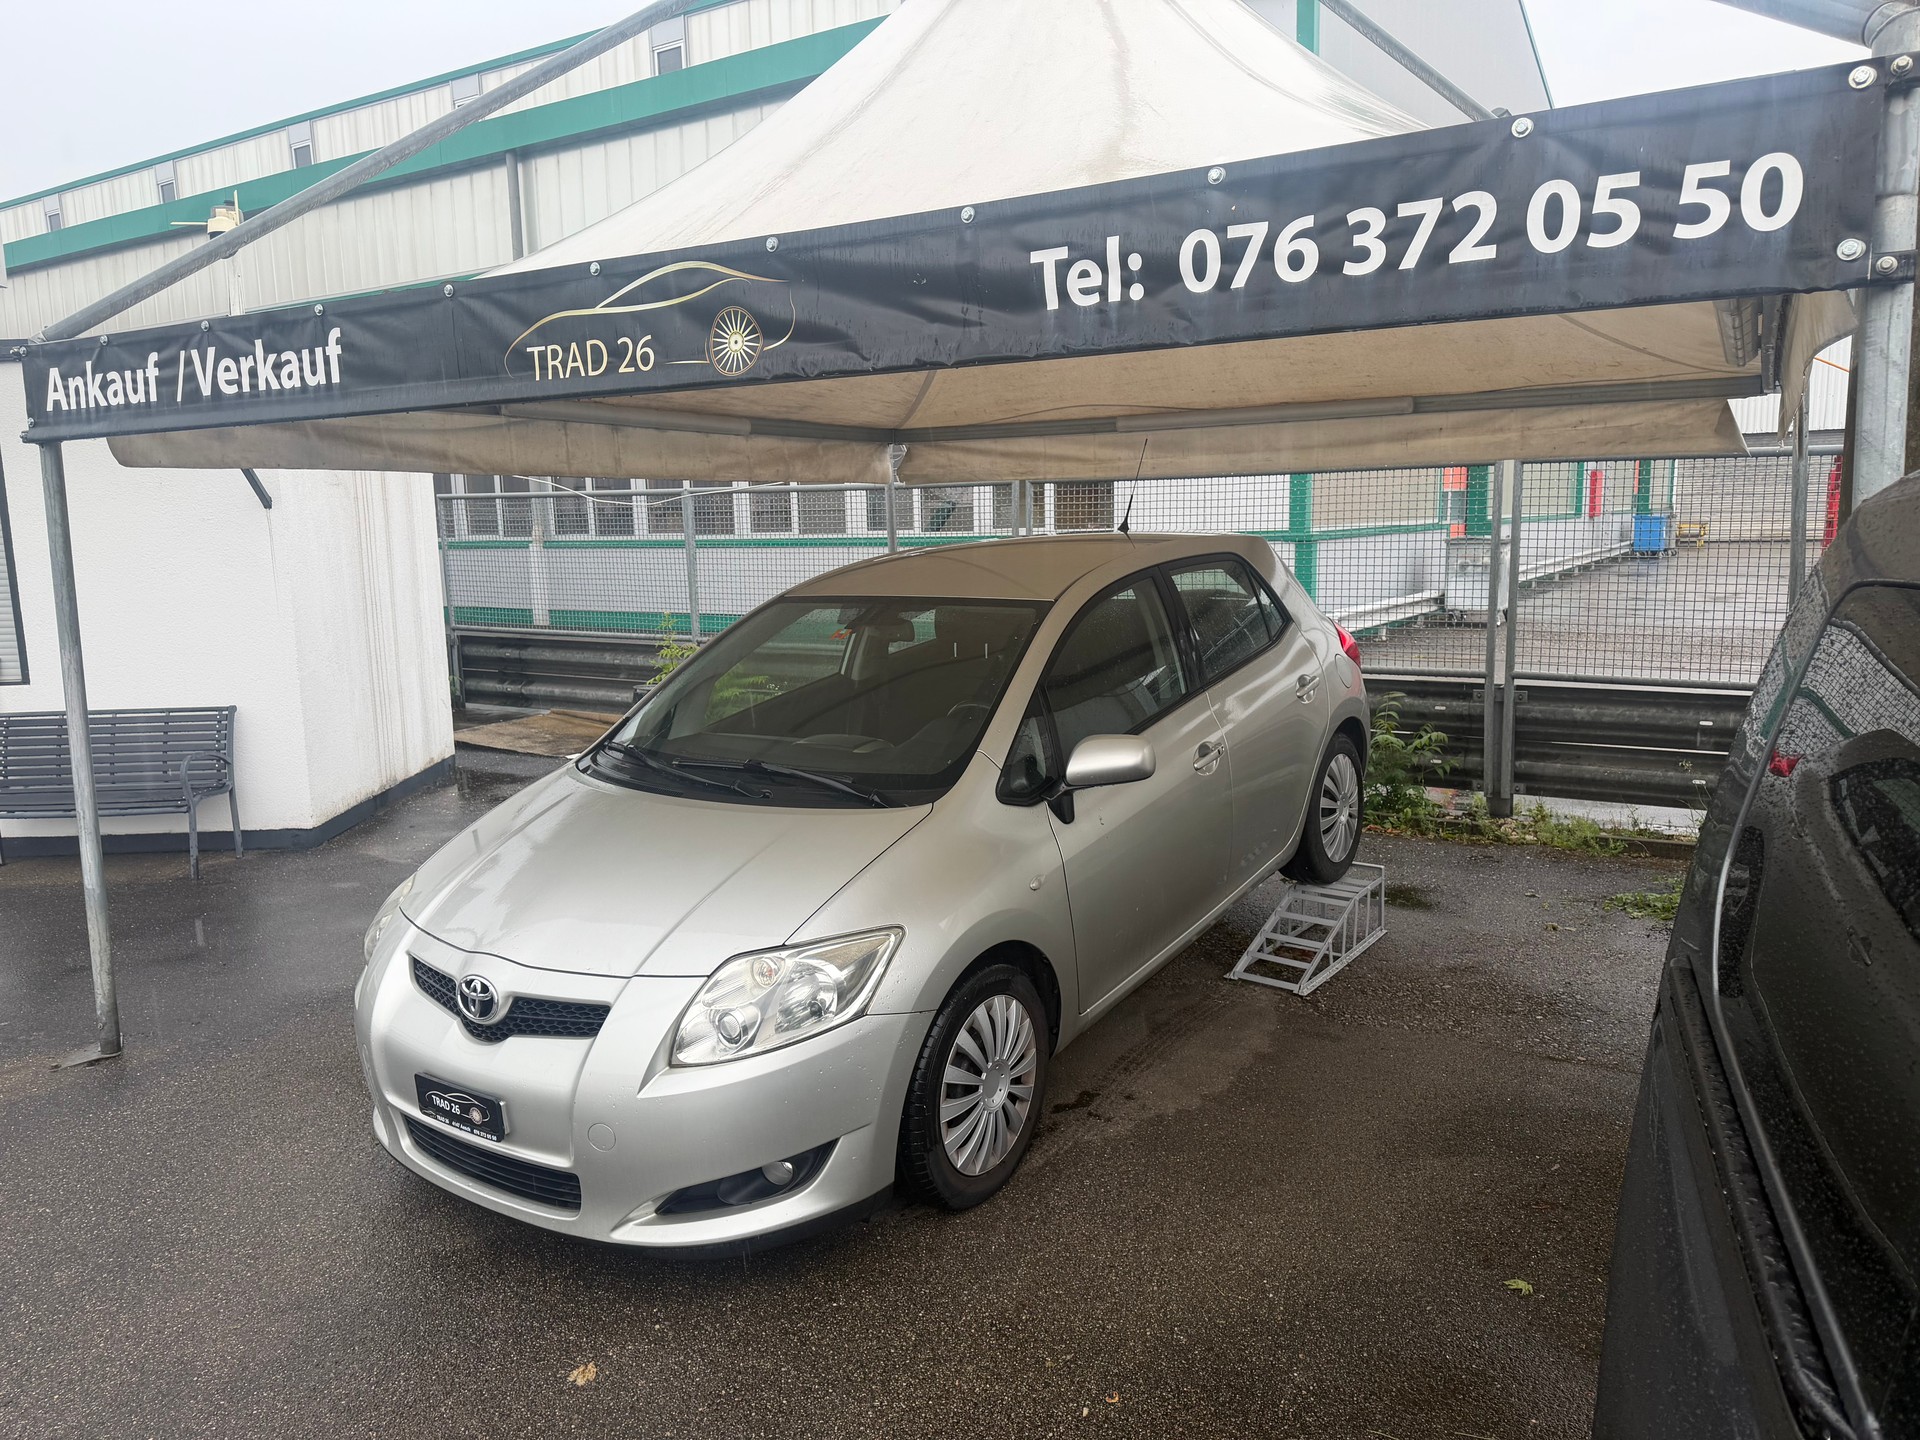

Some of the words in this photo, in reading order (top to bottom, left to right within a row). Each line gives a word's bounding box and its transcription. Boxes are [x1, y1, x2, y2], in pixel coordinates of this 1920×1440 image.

[1029, 235, 1145, 311] Tel:
[1178, 214, 1320, 294] 076
[1342, 190, 1498, 276] 372
[1526, 170, 1641, 254] 05
[1672, 151, 1804, 240] 50
[46, 351, 160, 412] Ankauf
[526, 339, 608, 382] TRAD
[616, 334, 656, 374] 26
[431, 1095, 450, 1110] TRAD
[451, 1103, 460, 1115] 26
